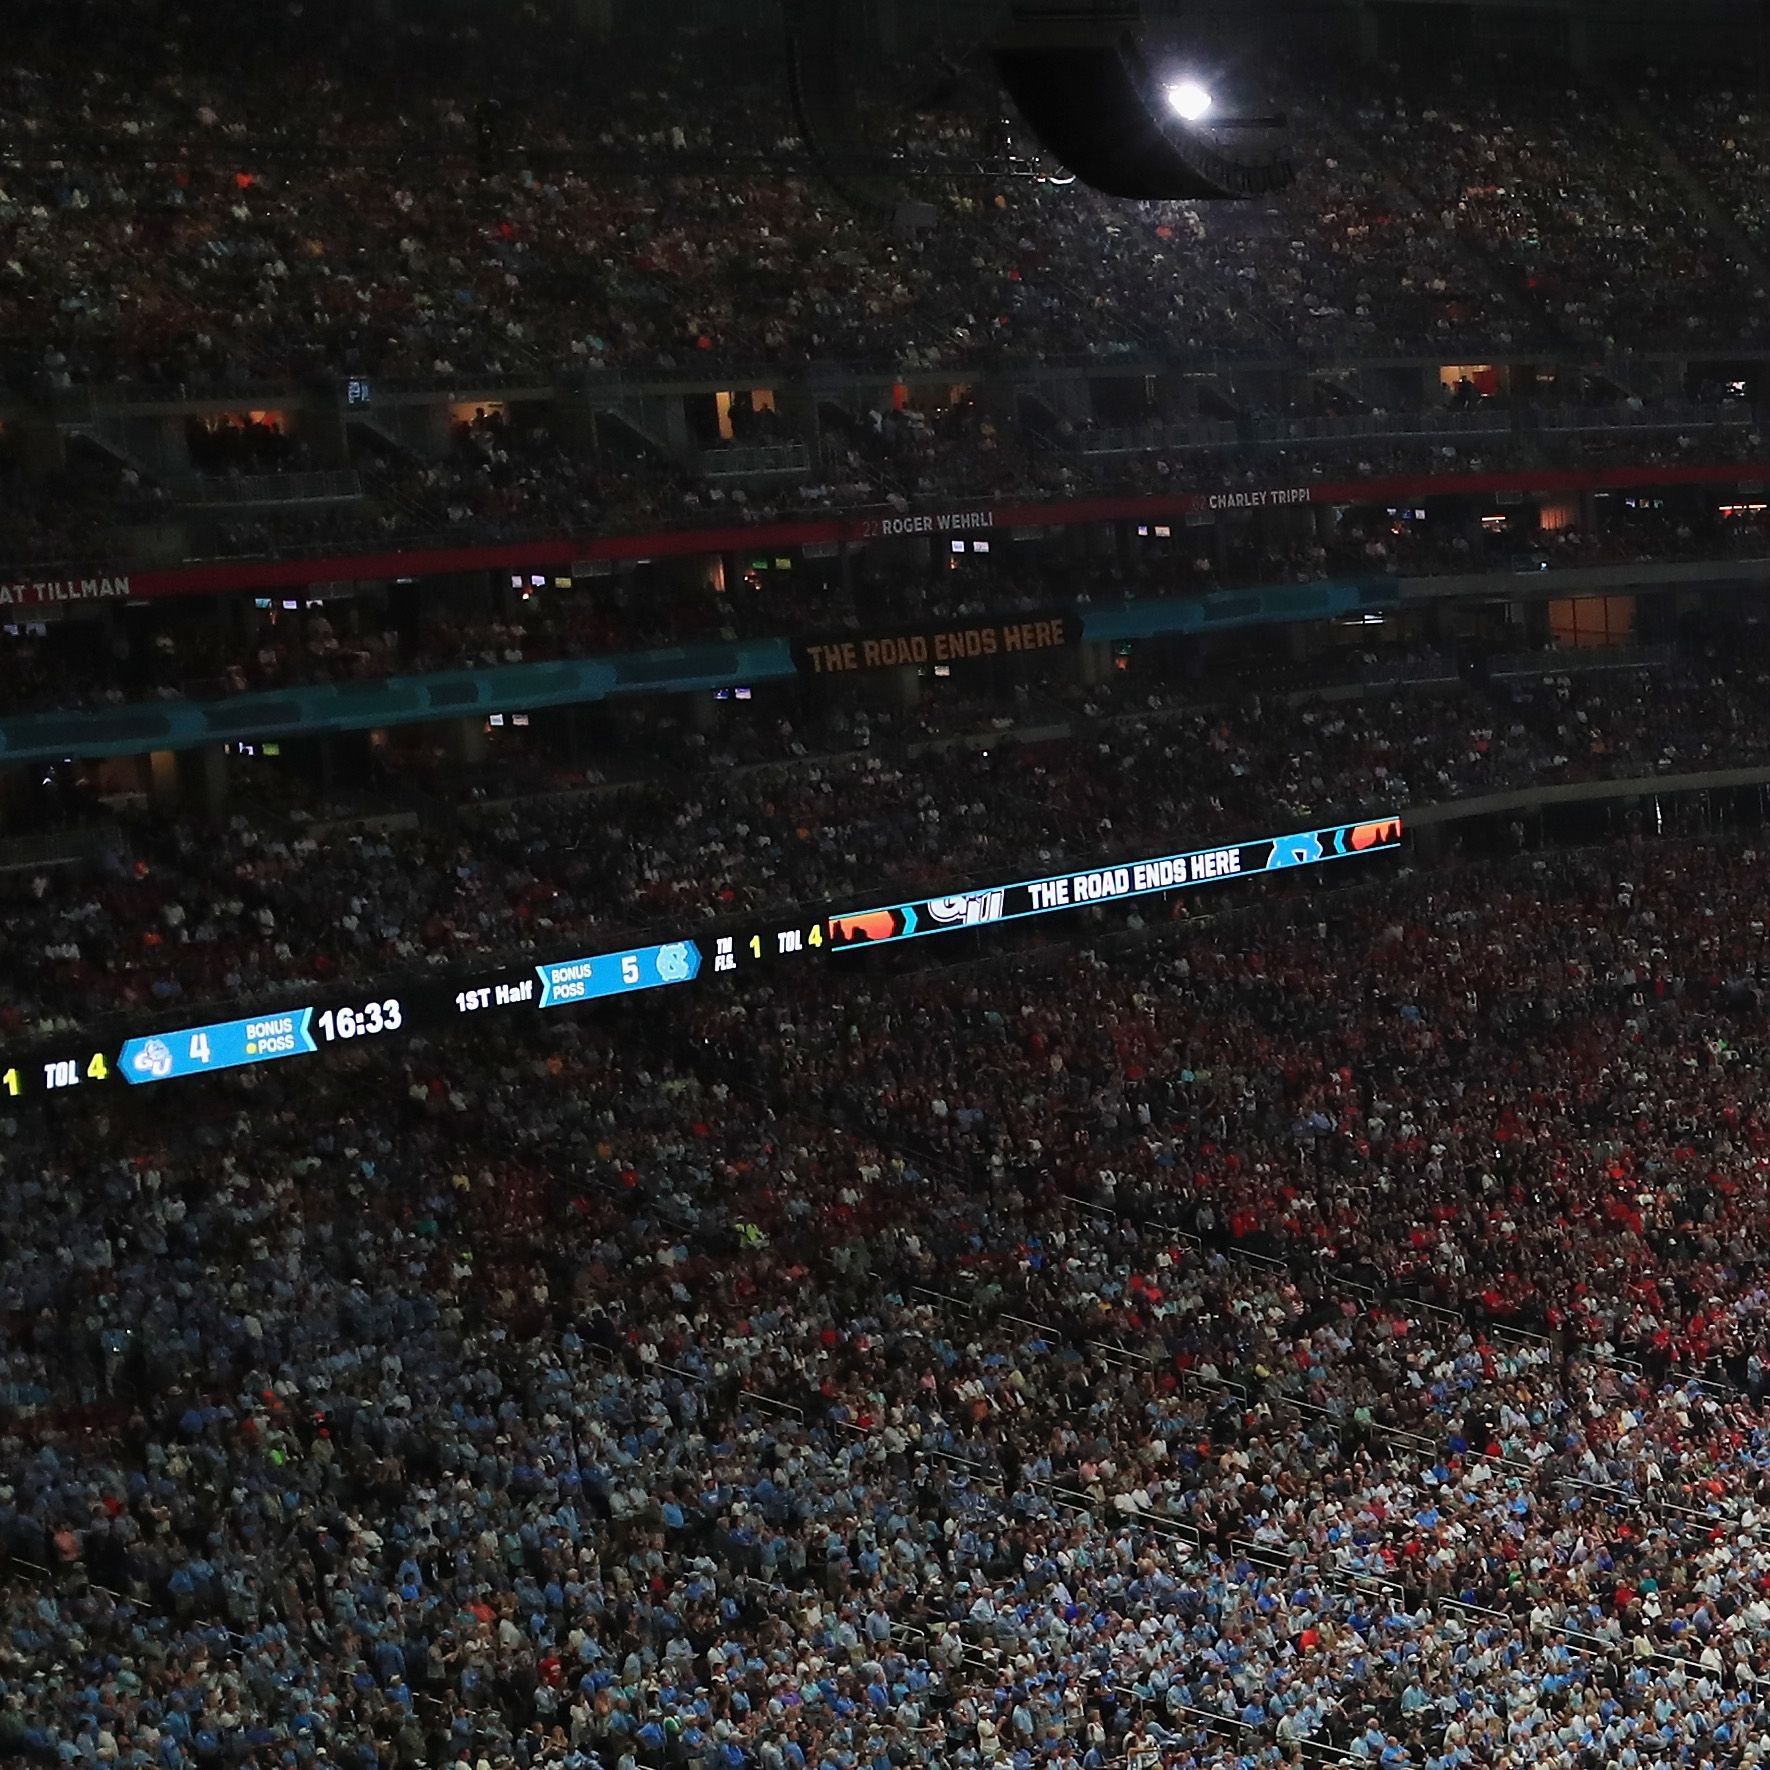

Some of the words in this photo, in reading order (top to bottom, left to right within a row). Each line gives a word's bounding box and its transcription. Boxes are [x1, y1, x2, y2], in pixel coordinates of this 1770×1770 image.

[1209, 491, 1268, 509] CHARLEY
[1270, 488, 1311, 504] TRIPPI
[882, 516, 932, 535] ROGER
[936, 512, 993, 530] WEHRLI
[33, 576, 130, 601] TILLMAN
[807, 643, 857, 673] THE
[862, 635, 928, 667] ROAD
[933, 627, 998, 661] ENDS
[1003, 618, 1064, 652] HERE
[1027, 879, 1070, 911] THE
[1073, 868, 1130, 902] ROAD
[1133, 858, 1188, 890] ENDS
[1190, 848, 1241, 879] HERE
[716, 937, 732, 955] TM
[749, 935, 761, 958] 1
[777, 930, 803, 954] TOL
[807, 924, 823, 947] 4
[551, 964, 592, 983] BONUS
[621, 956, 639, 984] 5
[714, 953, 737, 972] FLS.
[455, 988, 493, 1012] 1ST
[495, 980, 533, 1005] Half
[552, 981, 585, 1000] POSS
[246, 1018, 293, 1040] BONUS
[318, 998, 402, 1042] 16:33
[189, 1033, 210, 1062] 4
[258, 1034, 295, 1054] POSS
[2, 1068, 21, 1096] 1
[44, 1060, 80, 1089] TOL
[87, 1053, 108, 1080] 4
